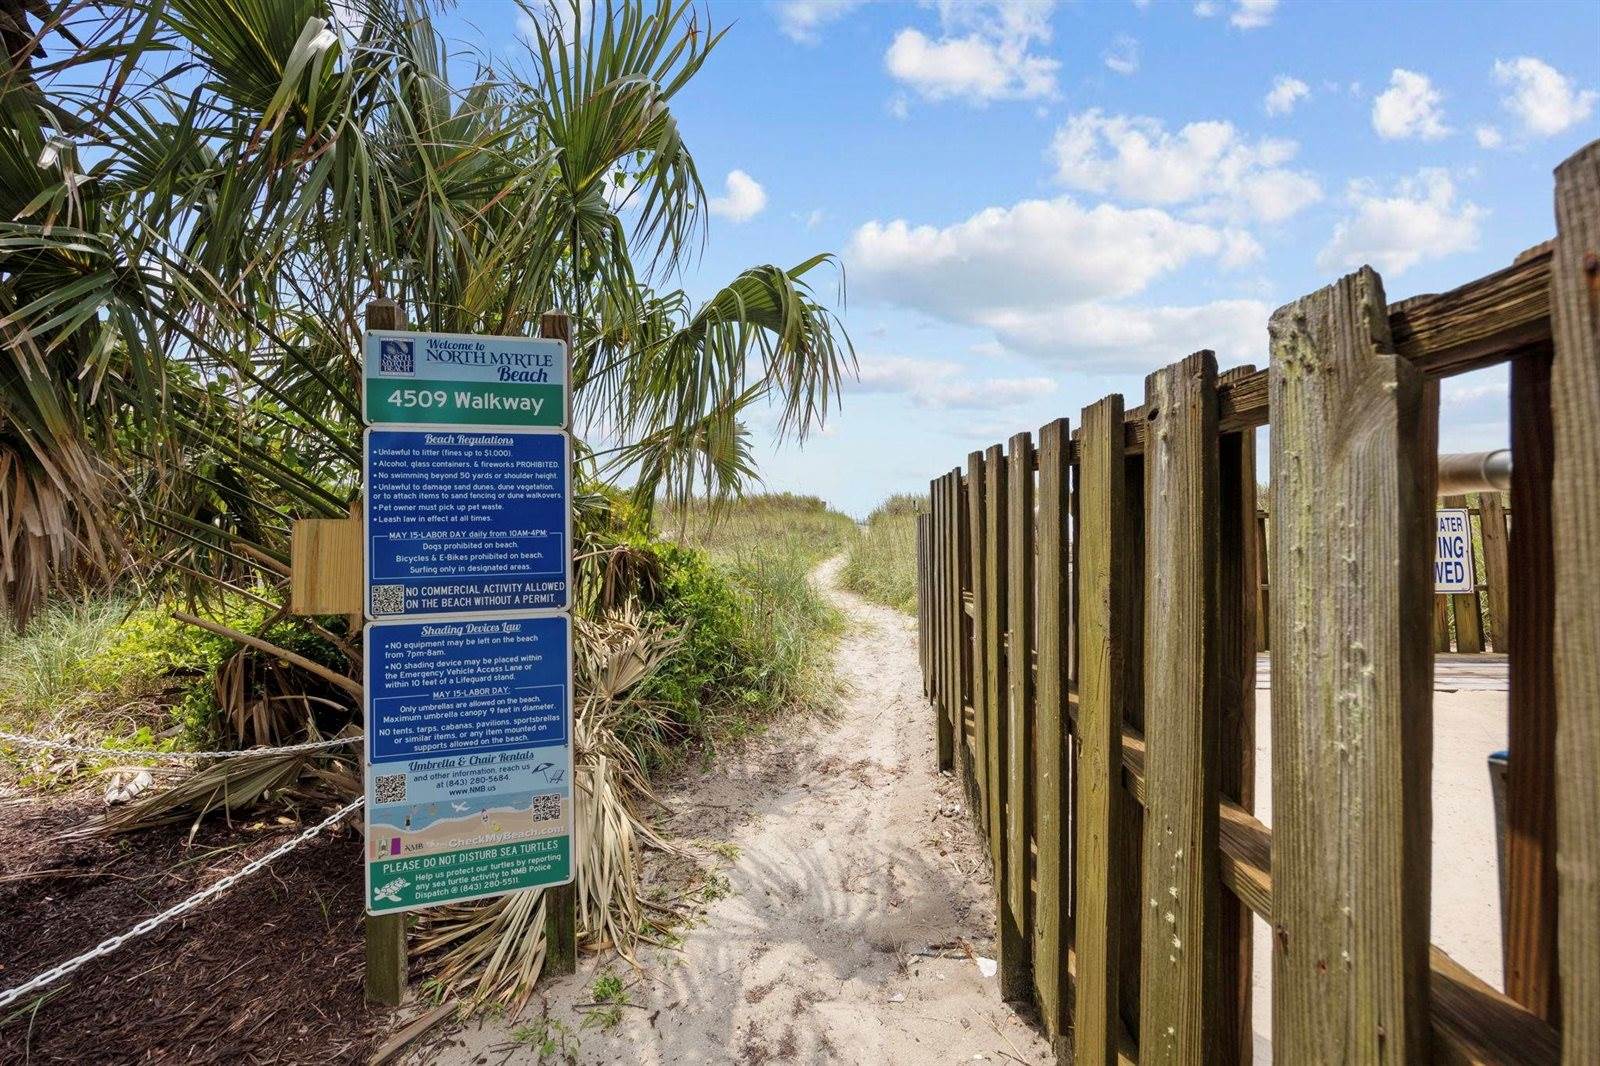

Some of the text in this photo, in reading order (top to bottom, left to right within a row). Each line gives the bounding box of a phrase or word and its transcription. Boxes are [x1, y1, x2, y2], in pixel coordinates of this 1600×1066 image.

[427, 339, 473, 350] Welcome
[426, 349, 552, 367] NORTH MYRTLE
[498, 366, 548, 382] Beach
[388, 390, 544, 415] 4509 Walkway
[425, 434, 514, 445] Beach Regulations
[423, 543, 441, 551] Dogs
[444, 542, 482, 550] prohibited
[470, 553, 508, 561] prohibited
[406, 582, 565, 596] NO COMMERCIAL ACTIVITY ALLOWED
[406, 600, 418, 608] ON
[421, 599, 438, 607] THE
[442, 597, 471, 607] BEACH
[474, 596, 512, 605] WITHOUT
[514, 596, 520, 604] A
[421, 623, 521, 636] Shading Devices Law
[404, 641, 445, 649] equipment
[404, 662, 434, 670] shading
[494, 656, 519, 665] placed
[385, 672, 398, 680] the
[401, 670, 444, 679] Emergency
[385, 681, 409, 689] within
[456, 675, 491, 684] Lifeguard
[409, 751, 534, 772] Umbrella & Chair Rentals
[414, 774, 428, 782] and
[430, 772, 450, 780] other
[446, 779, 467, 787] (843)
[383, 840, 559, 873] PLEASE DO NOT DISTURB SEA TURTLES
[415, 873, 433, 881] Help
[447, 868, 474, 878] protect
[490, 861, 514, 870] turtles
[517, 859, 526, 867] by
[528, 854, 561, 865] reporting
[415, 883, 429, 891] any
[448, 877, 469, 886] turtle
[471, 873, 500, 883] activity
[529, 864, 551, 873] Police
[415, 889, 449, 900] Dispatch
[451, 886, 458, 894] @
[460, 882, 481, 892] (843)
